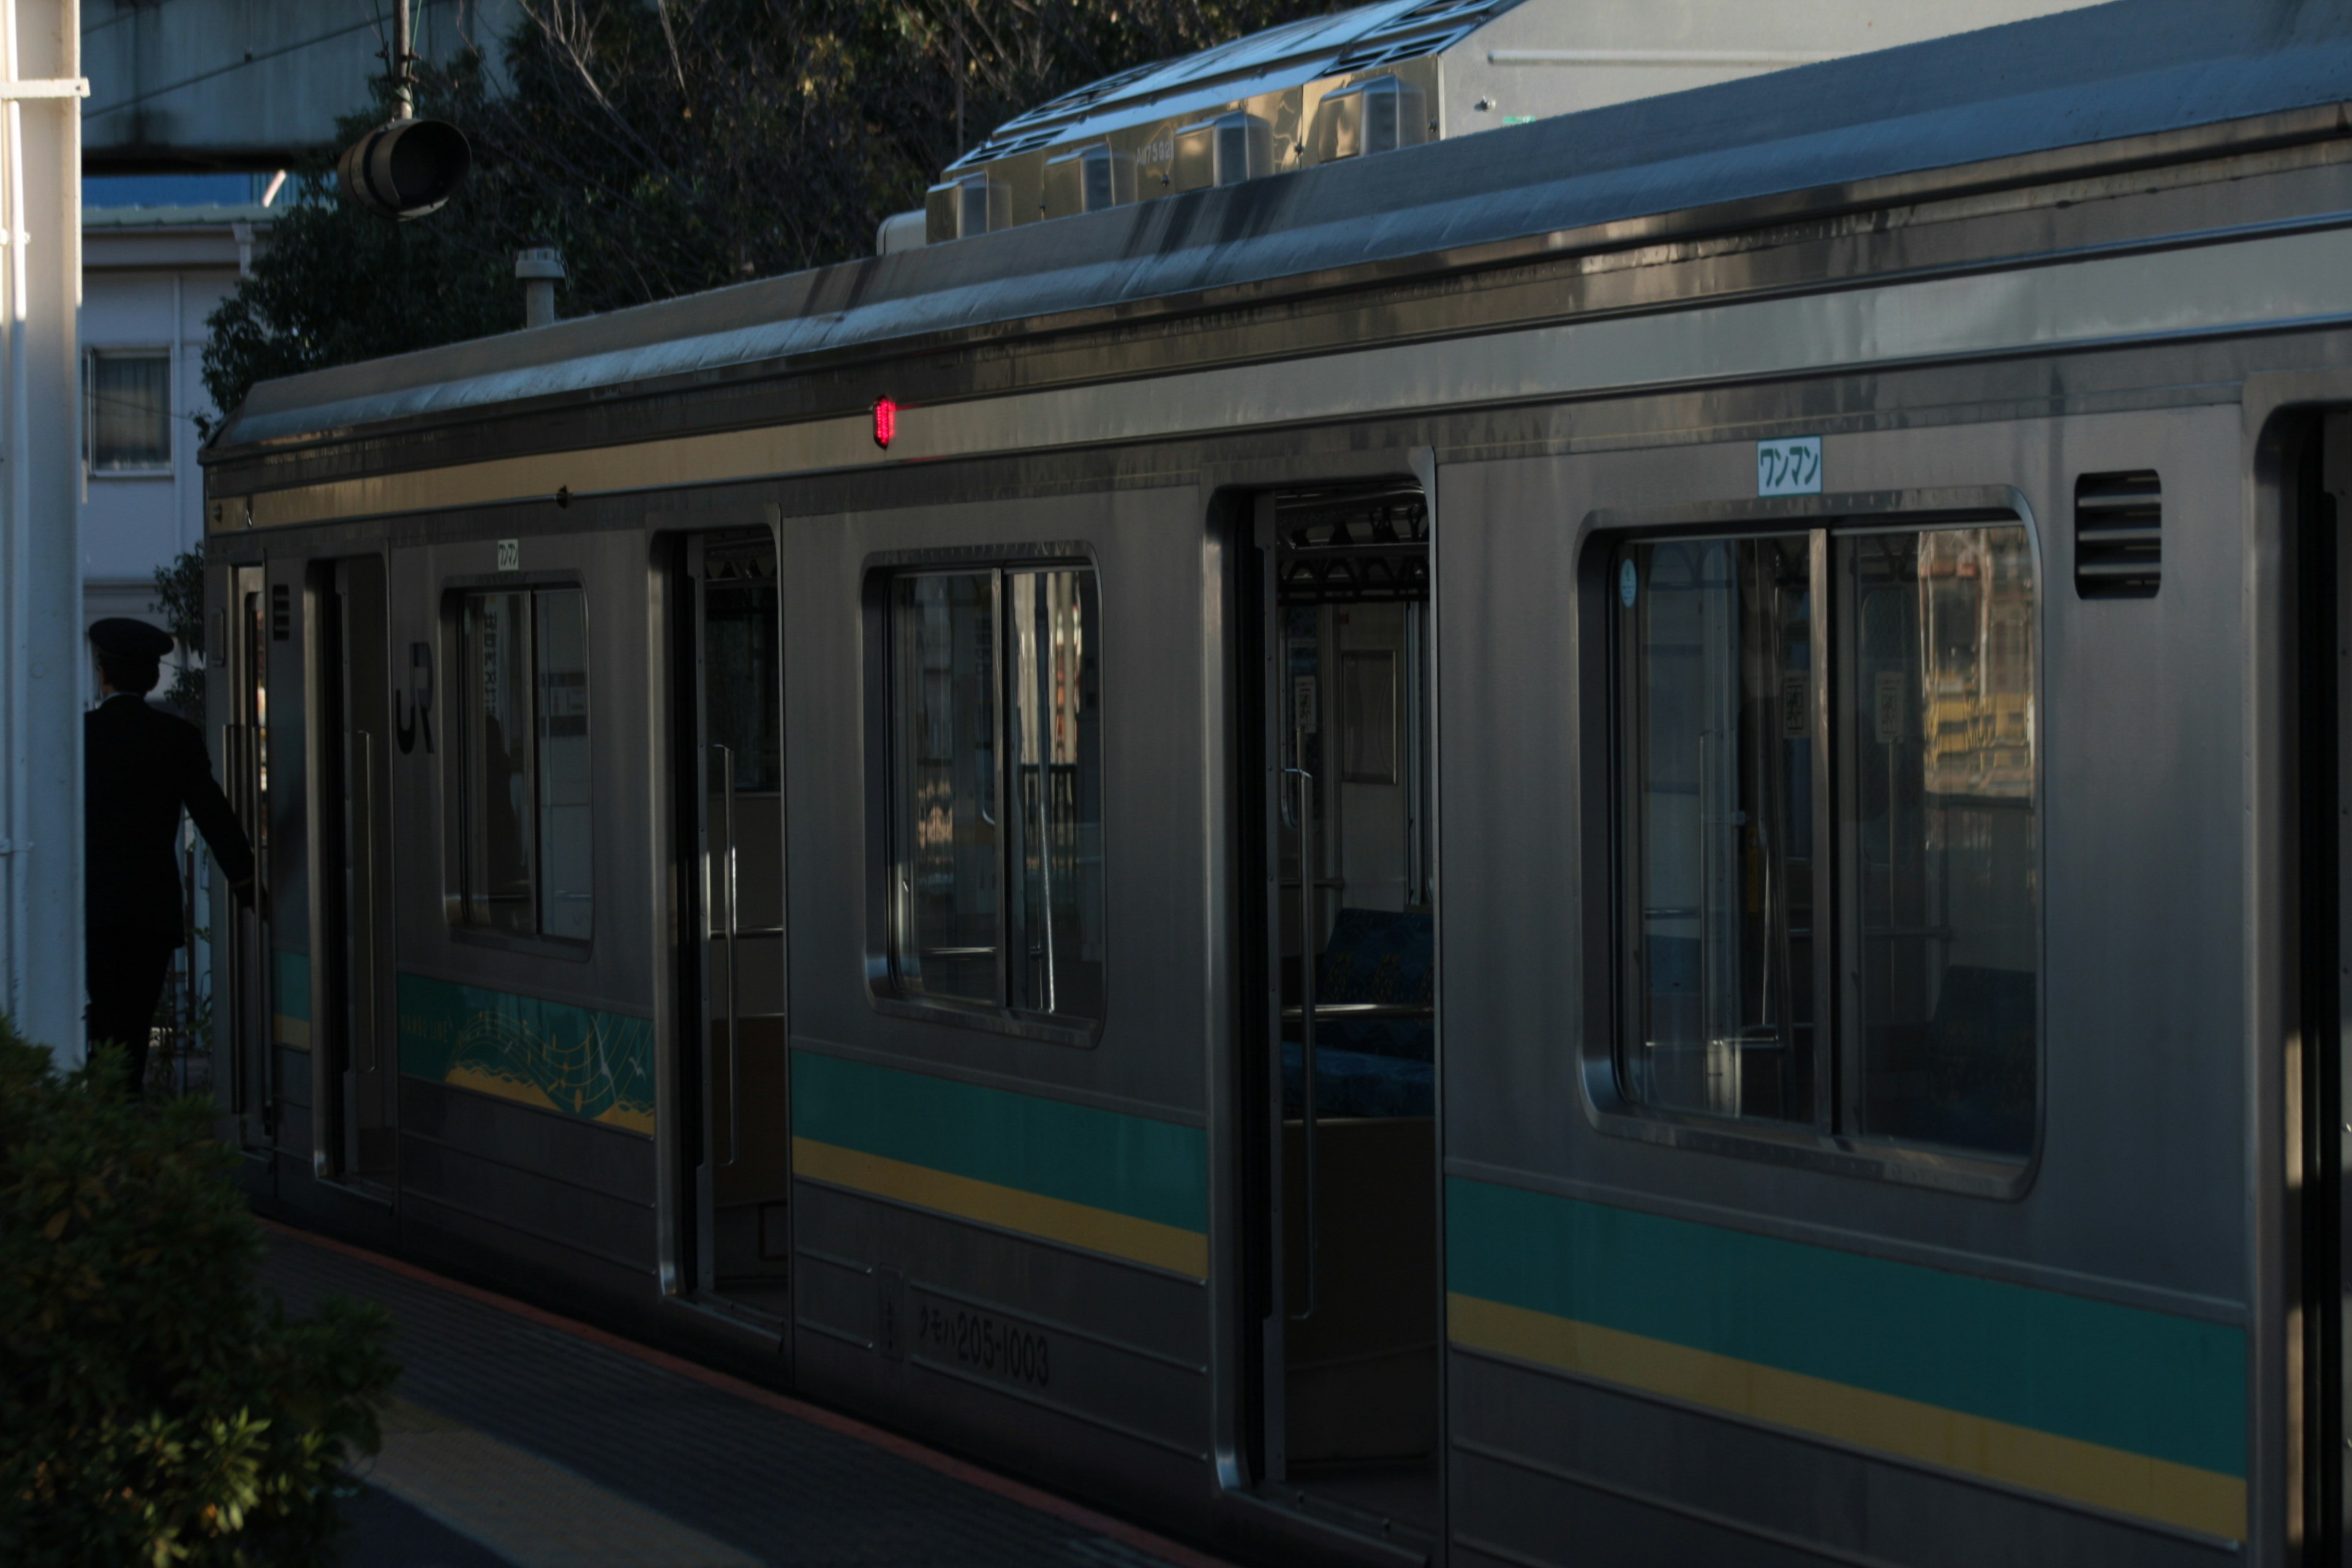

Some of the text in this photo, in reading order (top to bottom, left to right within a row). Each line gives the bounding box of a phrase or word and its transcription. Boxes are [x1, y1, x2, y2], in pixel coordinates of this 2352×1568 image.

[1760, 446, 1818, 488] ワンマン
[396, 641, 434, 755] JR
[921, 1305, 1049, 1387] クモハ205-1003
